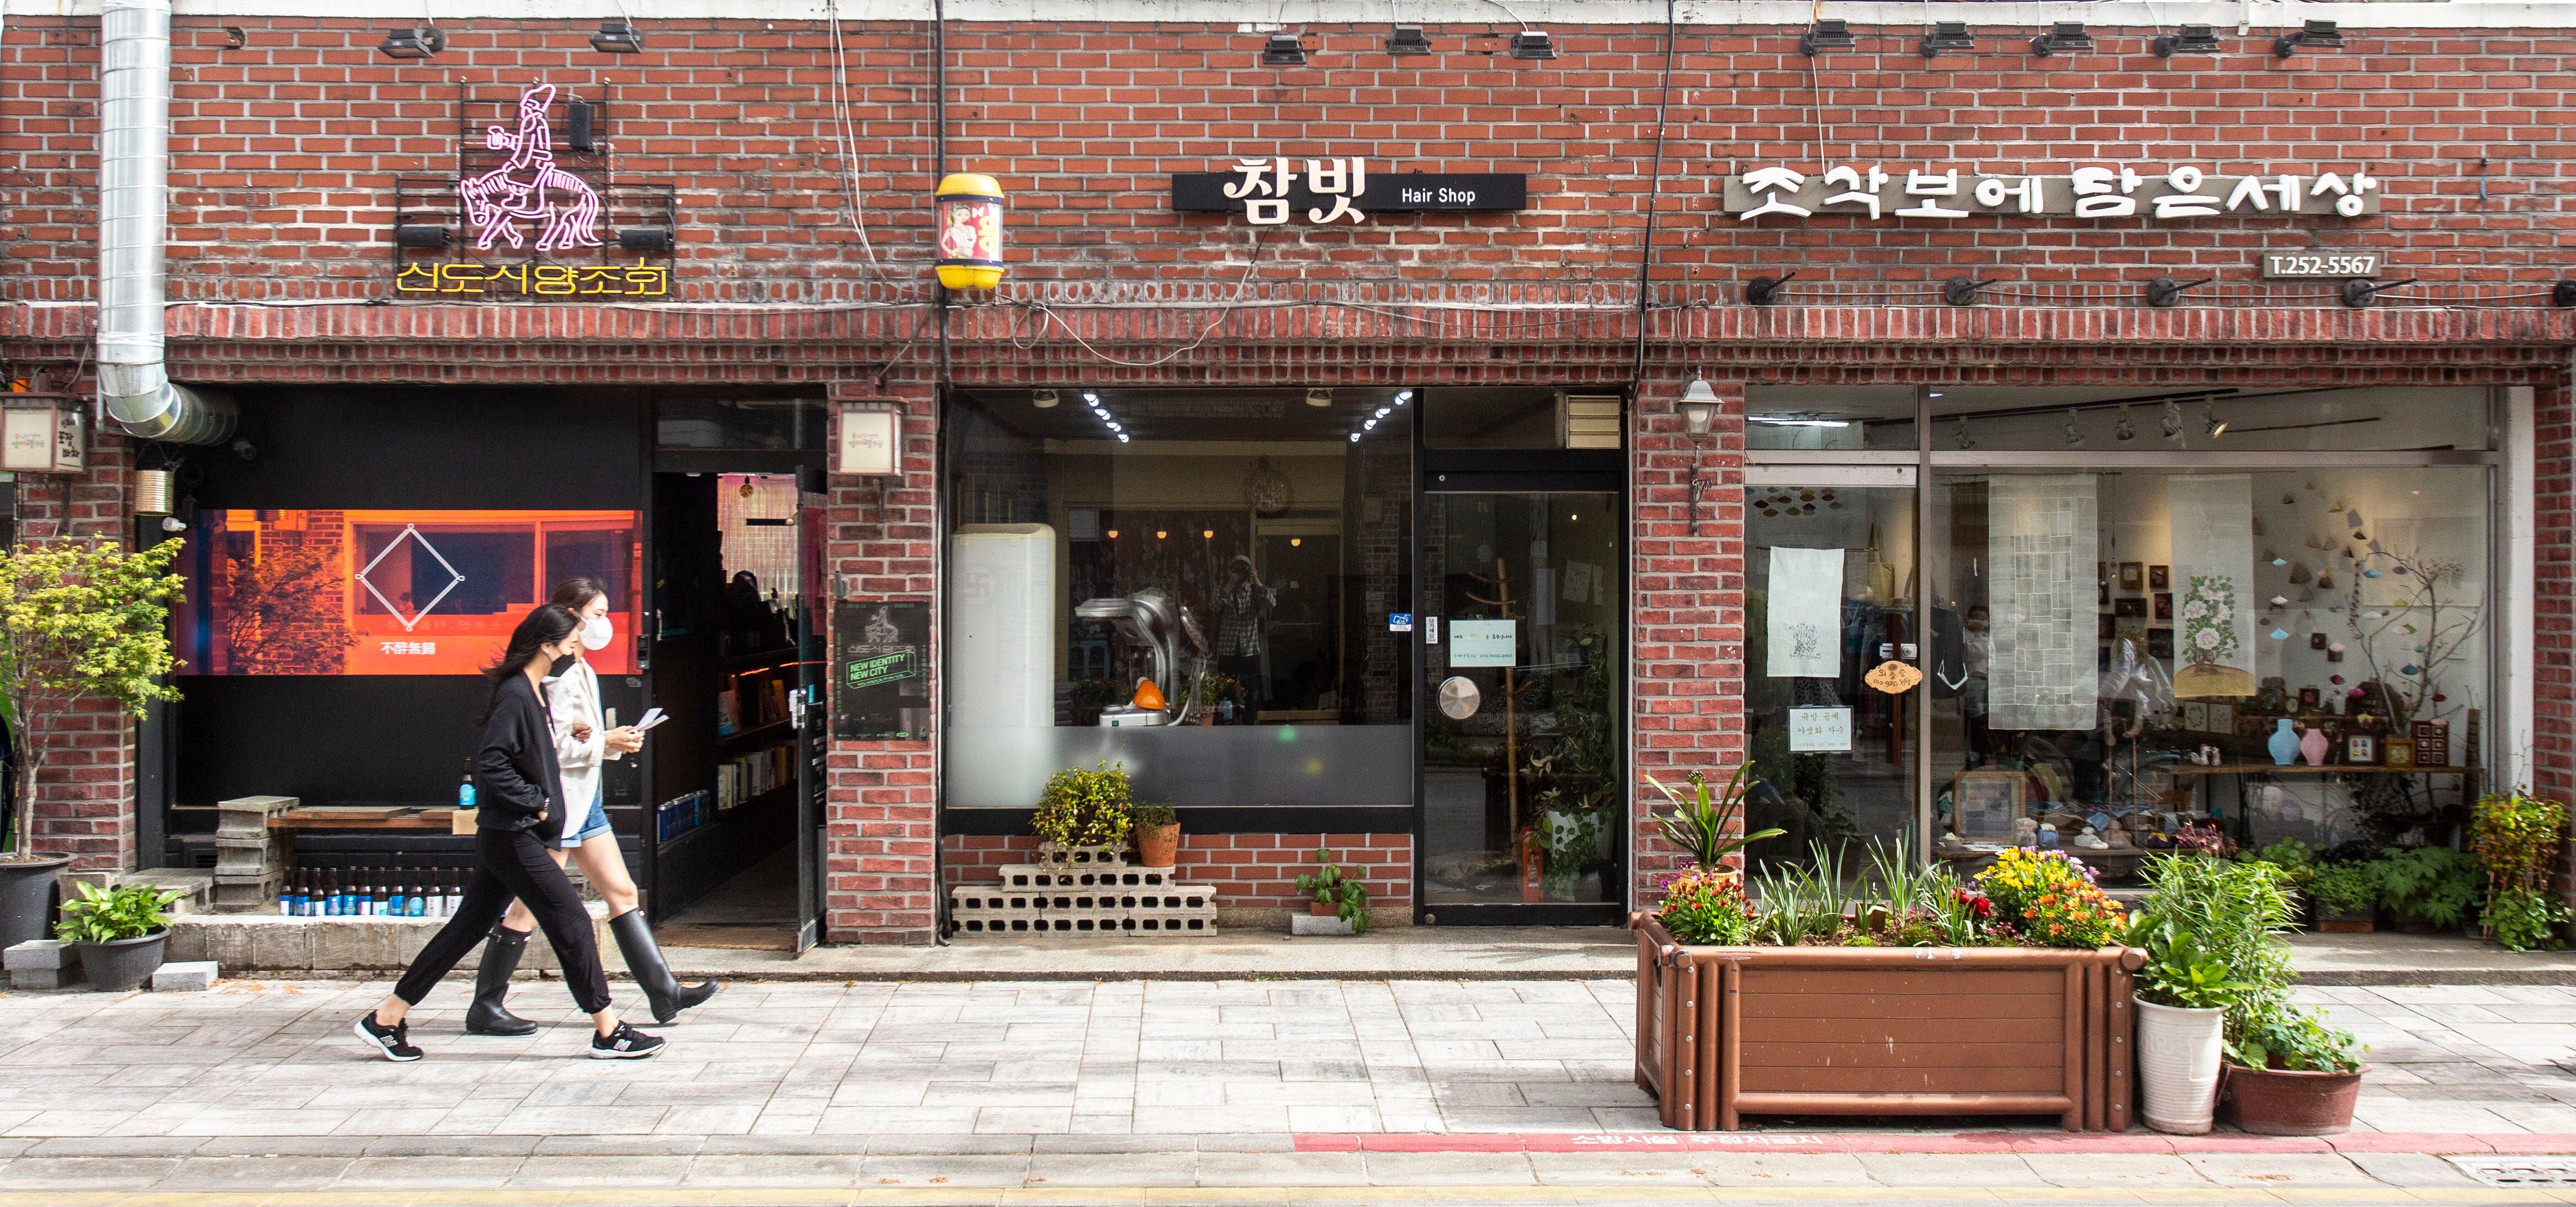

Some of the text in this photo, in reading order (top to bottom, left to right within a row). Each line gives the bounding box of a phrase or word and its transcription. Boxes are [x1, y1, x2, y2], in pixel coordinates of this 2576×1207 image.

[1223, 156, 1366, 224] 참빗
[1402, 188, 1475, 205] Hair Shop
[1740, 165, 2043, 220] 조각보에
[2271, 256, 2375, 274] T.252-5567
[396, 257, 666, 295] 신도시양조회
[850, 653, 905, 673] NEW IDENTITY
[850, 669, 869, 681] NEW
[869, 665, 888, 677] CITY
[1802, 712, 1839, 721] 규방 공예
[1797, 726, 1844, 735] 야생화 자수
[1571, 1135, 1824, 1145] 소방시설 주정차금지
